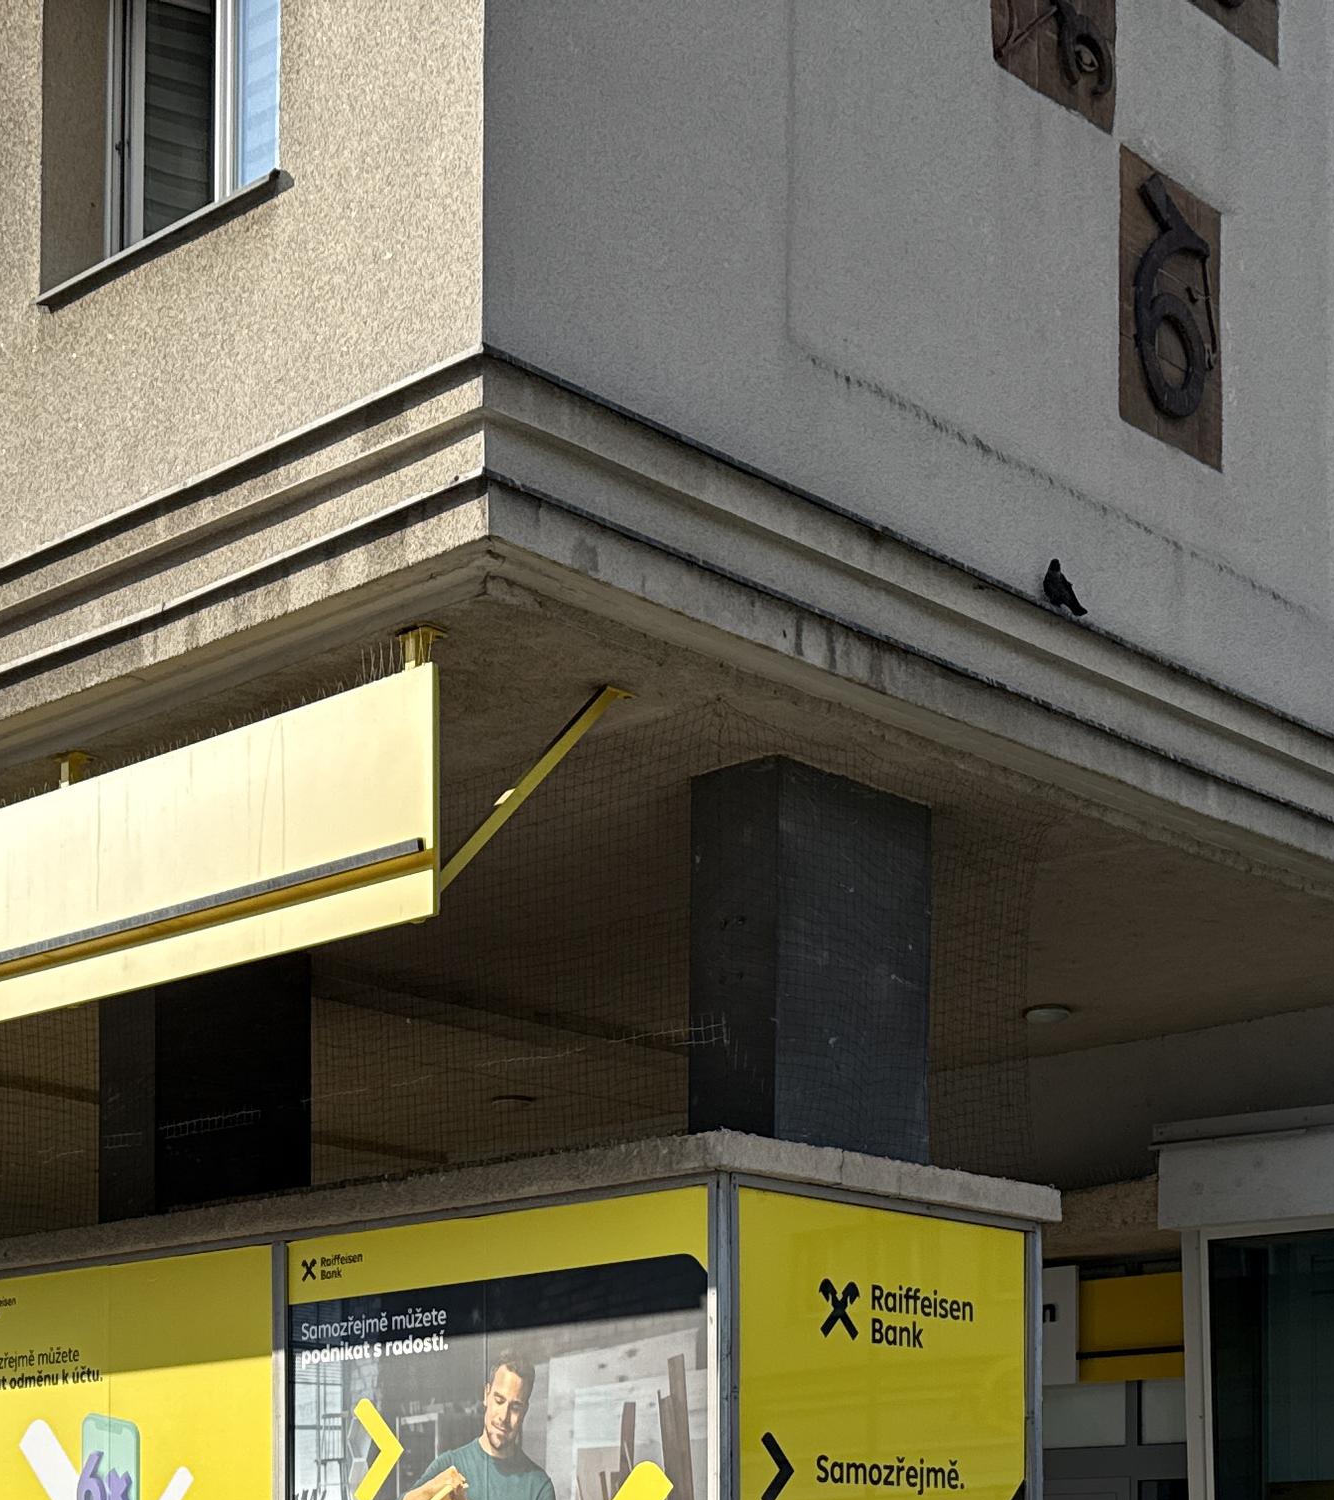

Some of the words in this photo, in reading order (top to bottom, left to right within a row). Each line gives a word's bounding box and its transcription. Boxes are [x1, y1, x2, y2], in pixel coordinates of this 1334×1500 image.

[320, 1252, 363, 1268] Raiffeisen
[320, 1267, 342, 1281] Bank
[870, 1284, 975, 1324] Raiffeisen
[301, 1312, 388, 1340] Samozřejmě
[391, 1307, 447, 1331] můžete
[870, 1318, 924, 1349] Bank
[37, 1347, 80, 1366] můžete
[301, 1340, 371, 1369] podnikat
[373, 1345, 383, 1358] s
[385, 1330, 449, 1357] radostí.
[9, 1369, 59, 1389] odměnu
[62, 1368, 69, 1385] k
[72, 1366, 103, 1384] účtu.
[815, 1454, 965, 1496] Samozřejmě.
